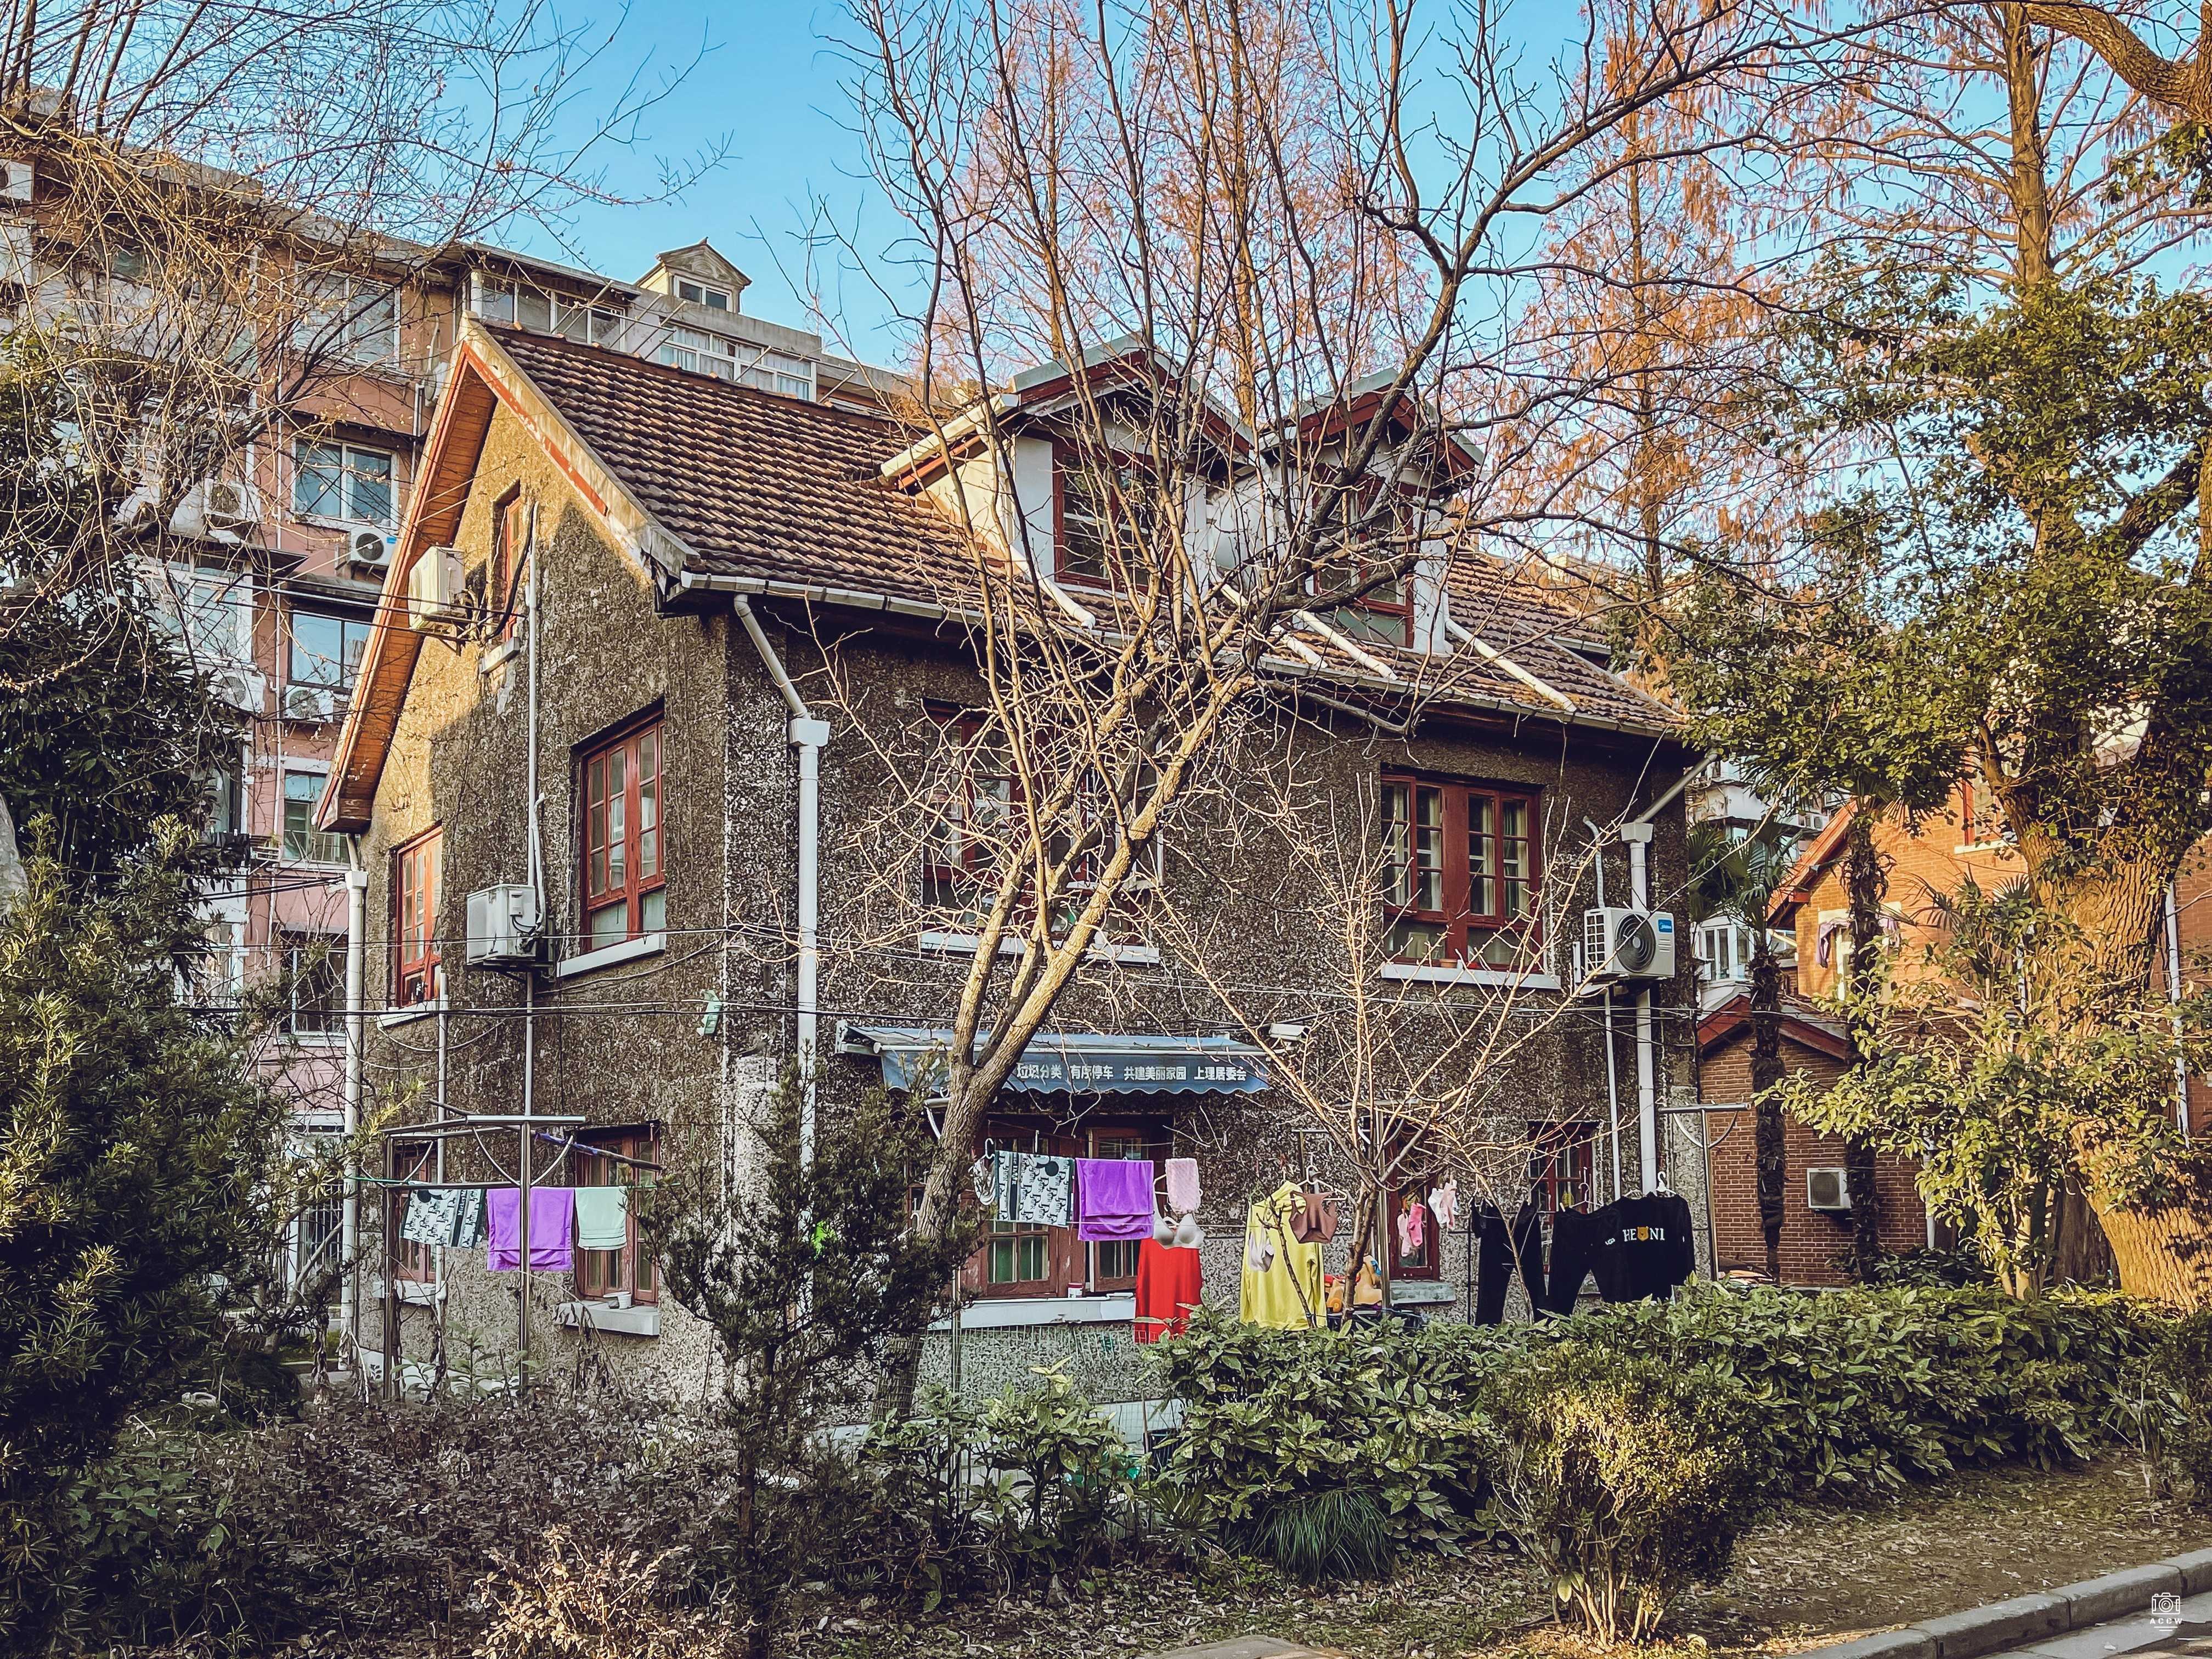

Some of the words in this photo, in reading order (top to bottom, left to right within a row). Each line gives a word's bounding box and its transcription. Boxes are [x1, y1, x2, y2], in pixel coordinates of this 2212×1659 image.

[1016, 1063, 1062, 1079] 垃圾分类
[1124, 1066, 1186, 1081] 共建美丽家园
[1194, 1066, 1246, 1081] 上理居委会
